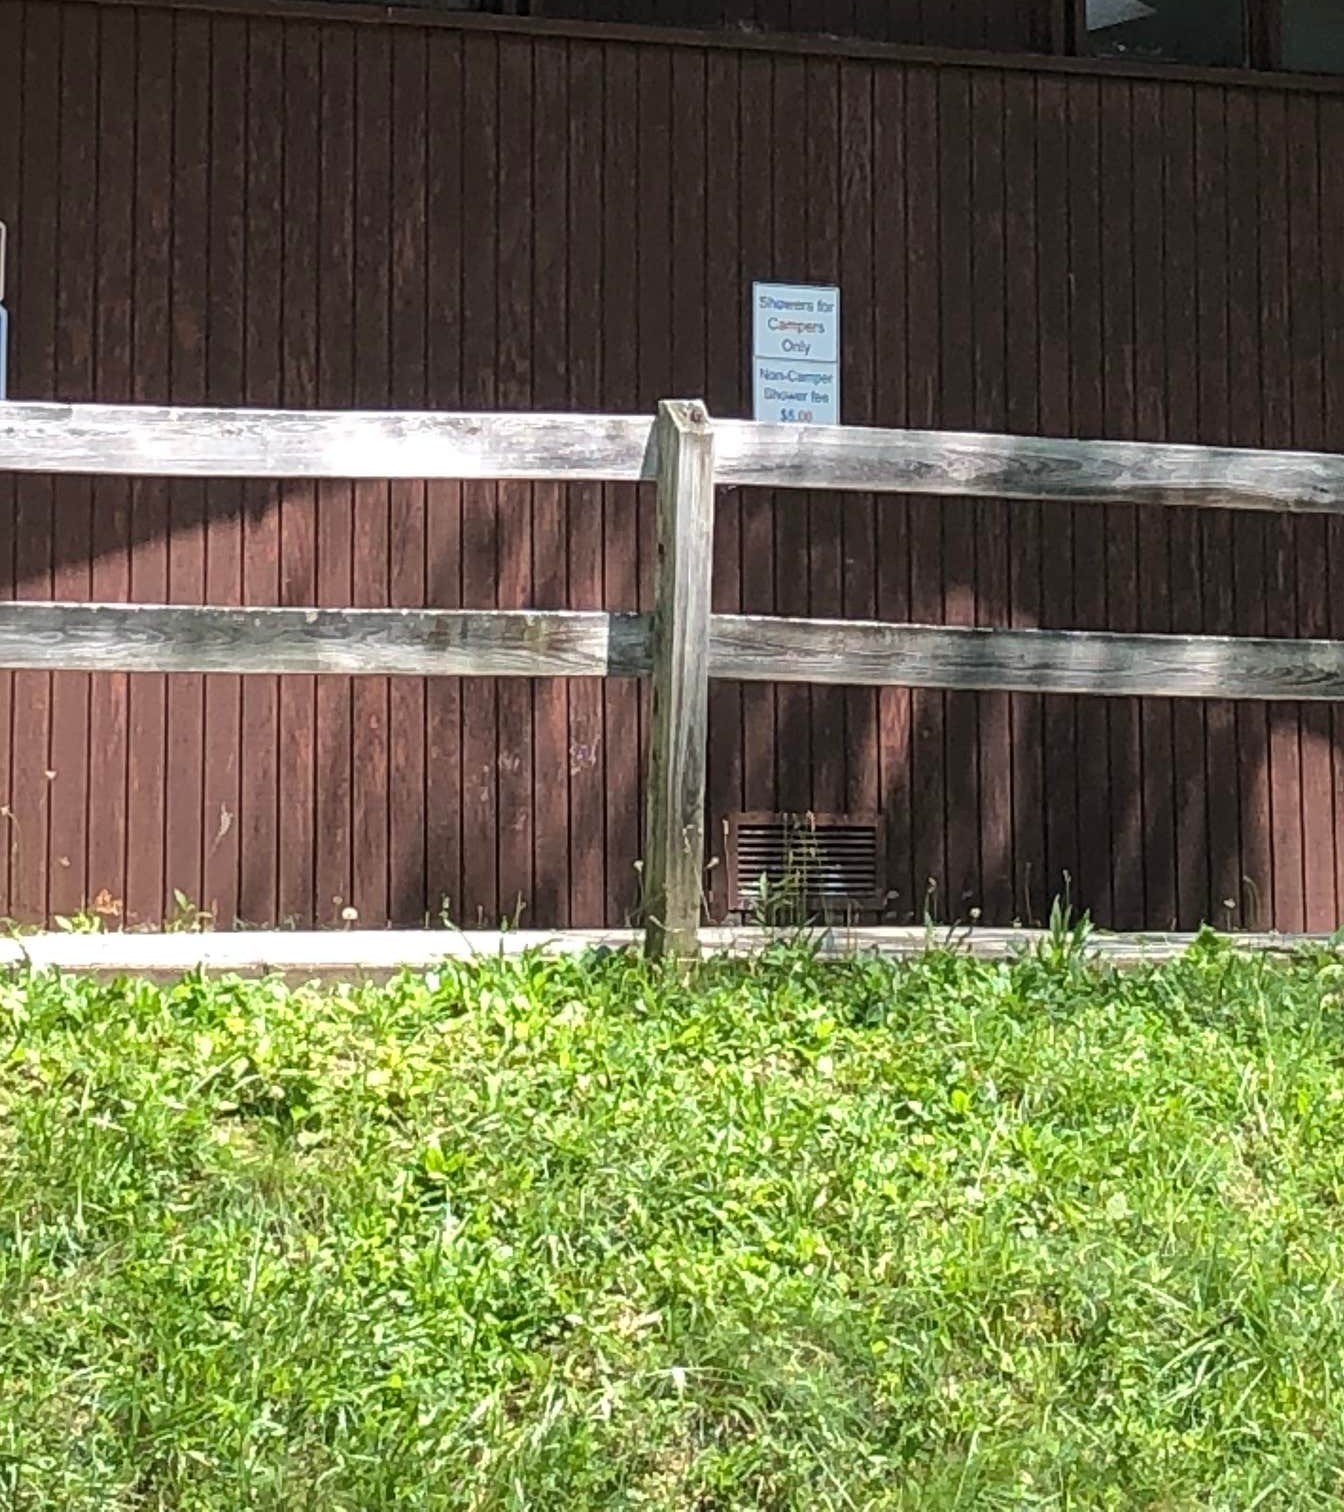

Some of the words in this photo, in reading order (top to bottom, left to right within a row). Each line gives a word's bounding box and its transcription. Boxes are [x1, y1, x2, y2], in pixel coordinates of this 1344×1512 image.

[760, 297, 813, 312] Showers
[817, 301, 834, 312] for
[768, 317, 824, 334] Campers
[782, 339, 811, 355] Only
[760, 368, 833, 386] Non-Camper
[764, 388, 808, 401] Shower
[811, 391, 829, 403] fee
